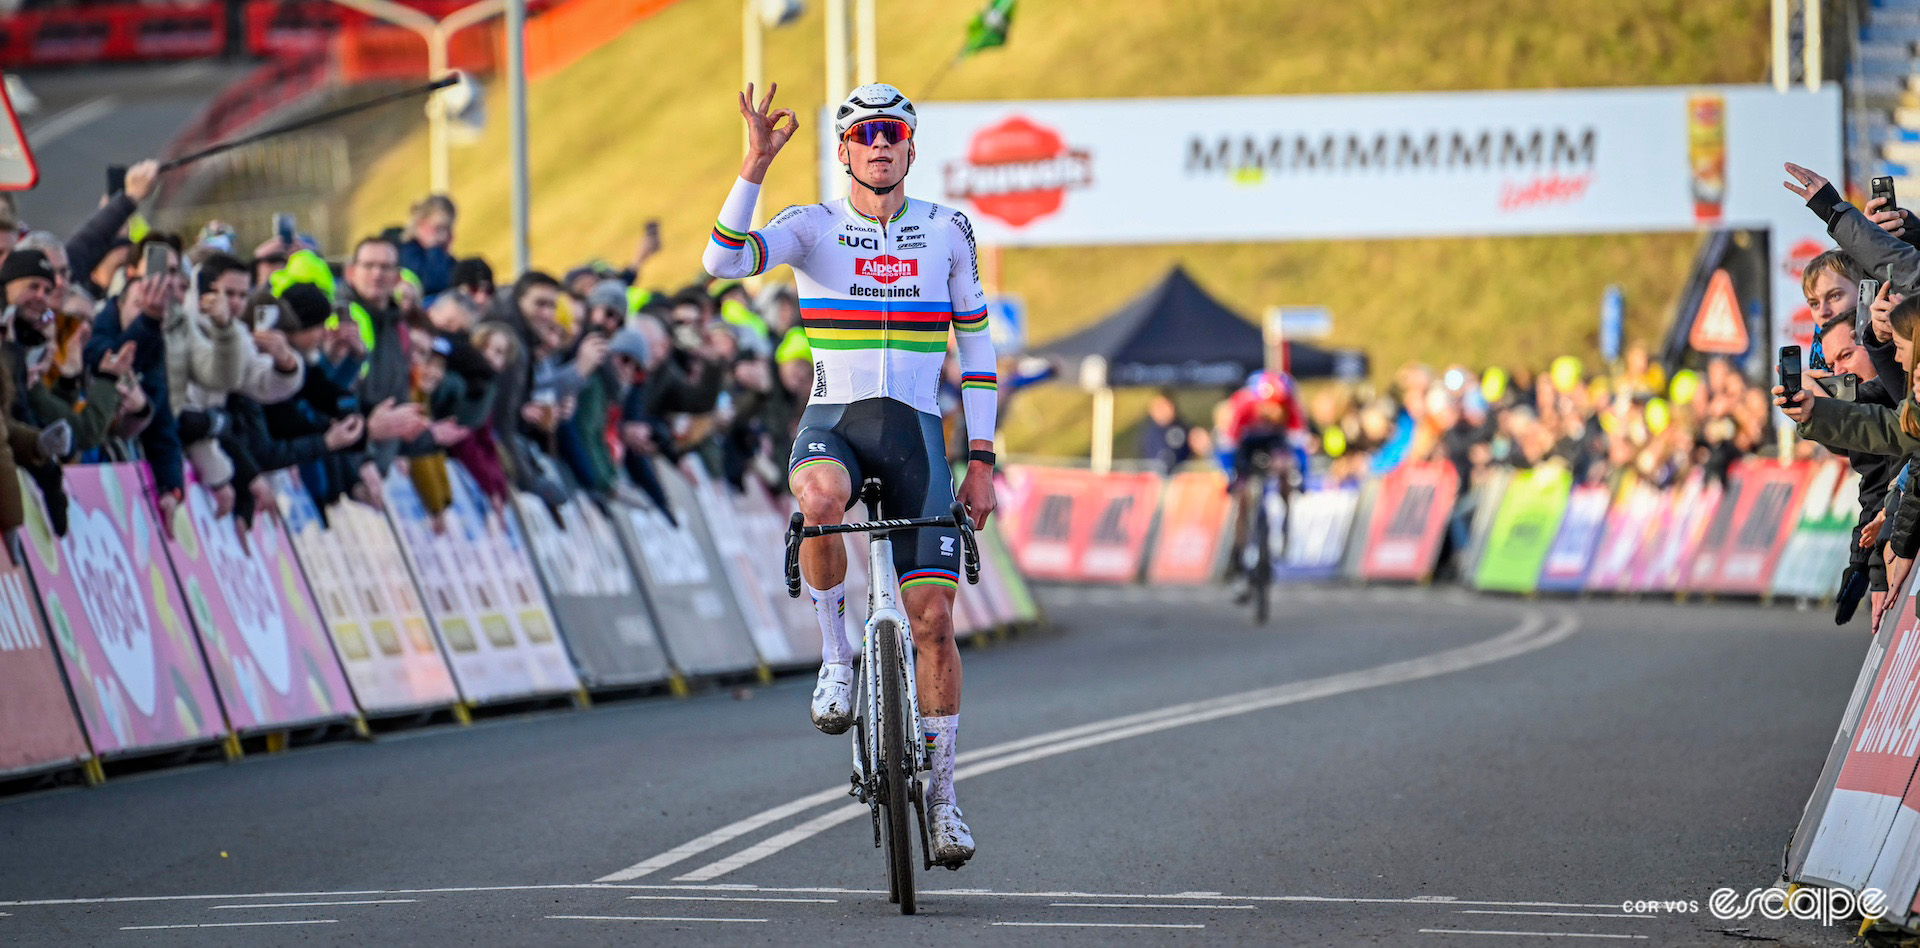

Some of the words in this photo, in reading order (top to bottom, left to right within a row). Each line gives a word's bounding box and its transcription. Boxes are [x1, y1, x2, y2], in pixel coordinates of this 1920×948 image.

[846, 235, 878, 250] UCI
[862, 260, 912, 277] Alpecin
[849, 283, 920, 298] deceuninck
[813, 361, 824, 398] Alpecin
